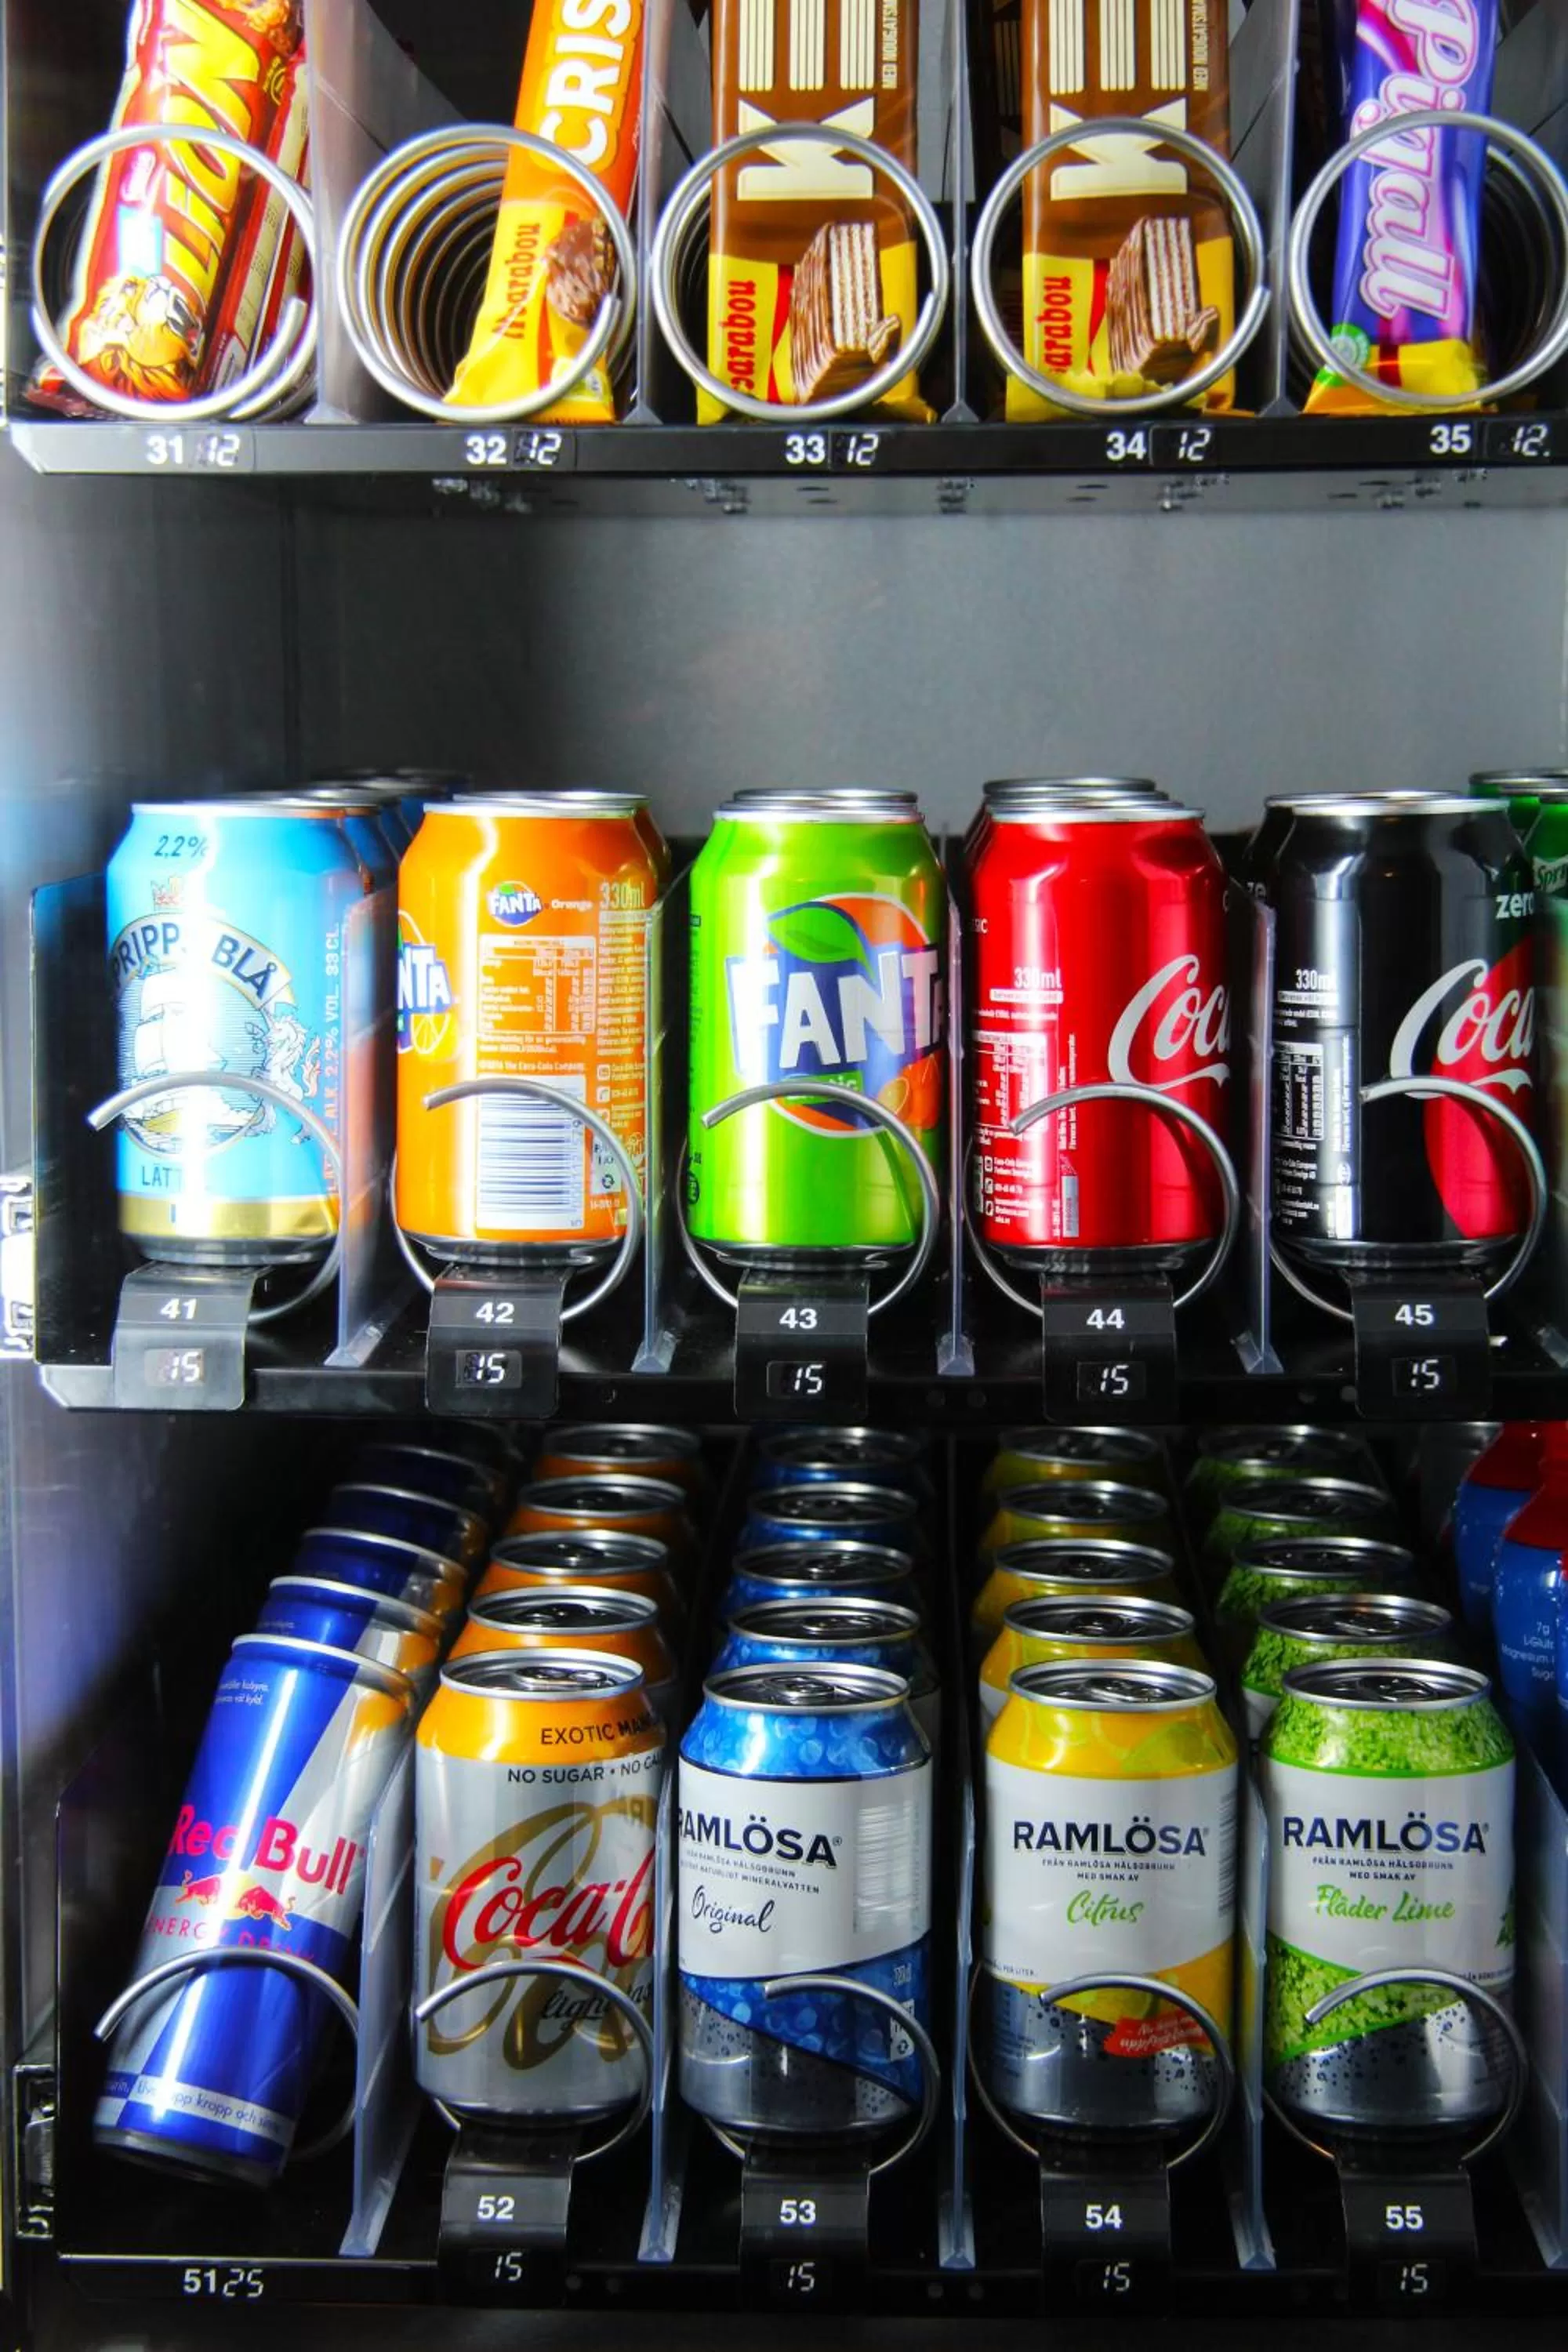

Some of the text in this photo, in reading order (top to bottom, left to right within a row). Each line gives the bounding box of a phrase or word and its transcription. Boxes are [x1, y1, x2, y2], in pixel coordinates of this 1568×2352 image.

[881, 63, 898, 89] MED
[1192, 67, 1208, 91] MED
[1354, 0, 1479, 320] Pigall
[1036, 276, 1073, 374] arabou
[147, 434, 241, 466] 31 12
[466, 434, 562, 466] 32 12
[786, 433, 879, 466] 33 12
[1106, 427, 1211, 461] 34 12
[1430, 424, 1471, 454] 35
[488, 891, 593, 914] FANTA Orange
[111, 920, 278, 1000] PRIPP BLÅ
[397, 944, 452, 1010] NTA
[160, 1298, 198, 1320] 41
[476, 1301, 515, 1323] 42
[779, 1308, 818, 1330] 43
[1086, 1308, 1125, 1330] 44
[1395, 1304, 1434, 1326] 45
[169, 1351, 201, 1383] 15
[476, 1352, 506, 1385] 15
[793, 1363, 823, 1395] 15
[1099, 1363, 1129, 1396] 15
[1410, 1359, 1439, 1389] 15
[540, 1722, 615, 1745] EXOTIC
[508, 1768, 535, 1784] NO
[542, 1766, 604, 1784] SUGAR
[620, 1760, 641, 1777] NO
[679, 1806, 837, 1867] RAMLÖSA
[1013, 1816, 1206, 1857] RAMLÖSA
[1283, 1811, 1486, 1853] RAMLÖSA
[254, 1815, 358, 1896] Bull
[1067, 1859, 1111, 1869] RAMLÖSA
[1339, 1856, 1385, 1867] RAMLÖSA
[742, 1875, 819, 1894] MINERALVATTEN
[1076, 1871, 1097, 1880] MED
[1099, 1872, 1125, 1881] SMAK
[1373, 1871, 1401, 1880] SMAK
[691, 1885, 775, 1934] Original
[1066, 1889, 1145, 1926] Citrus
[1316, 1884, 1456, 1922] Fläder Lime
[196, 2093, 233, 2118] kropp
[477, 2195, 515, 2220] 52
[779, 2200, 817, 2225] 53
[1085, 2205, 1123, 2229] 54
[1385, 2205, 1424, 2230] 55
[495, 2252, 523, 2281] 15
[787, 2262, 815, 2292] 15
[1103, 2263, 1131, 2292] 15
[1400, 2263, 1428, 2293] 15
[183, 2268, 264, 2298] 51 25
